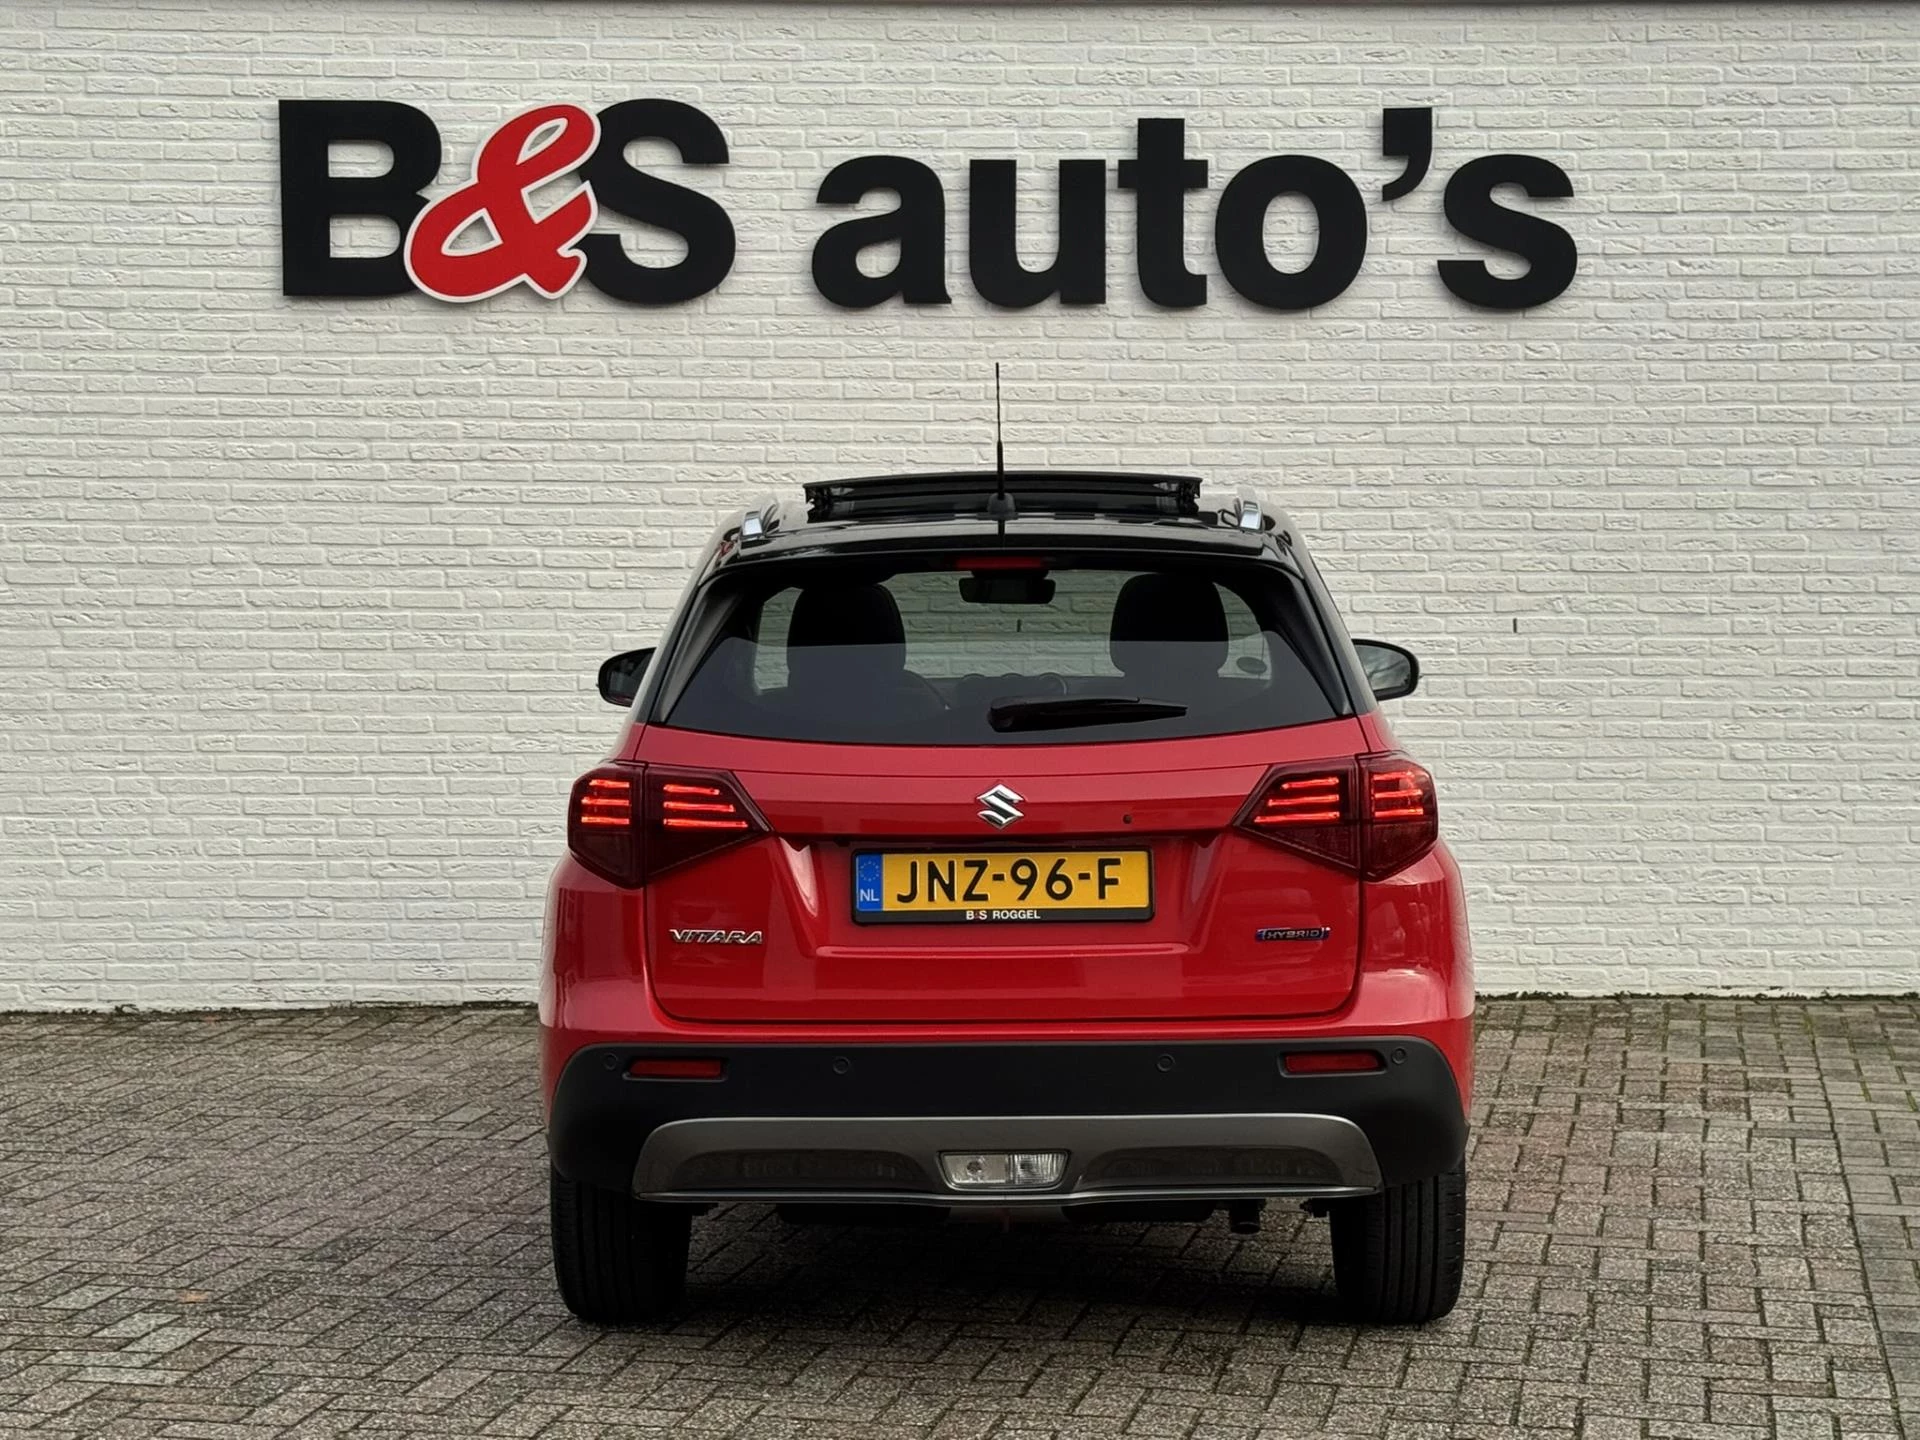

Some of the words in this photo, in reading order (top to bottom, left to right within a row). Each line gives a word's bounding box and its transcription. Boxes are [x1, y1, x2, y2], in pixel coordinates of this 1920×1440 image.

[280, 99, 736, 306] B&S
[811, 107, 1577, 310] auto's
[897, 858, 1121, 903] JNZ-96-F
[860, 889, 880, 902] NL
[993, 910, 1041, 920] ROGGEL
[669, 928, 763, 944] VITARA
[1266, 930, 1320, 939] HYBRID
